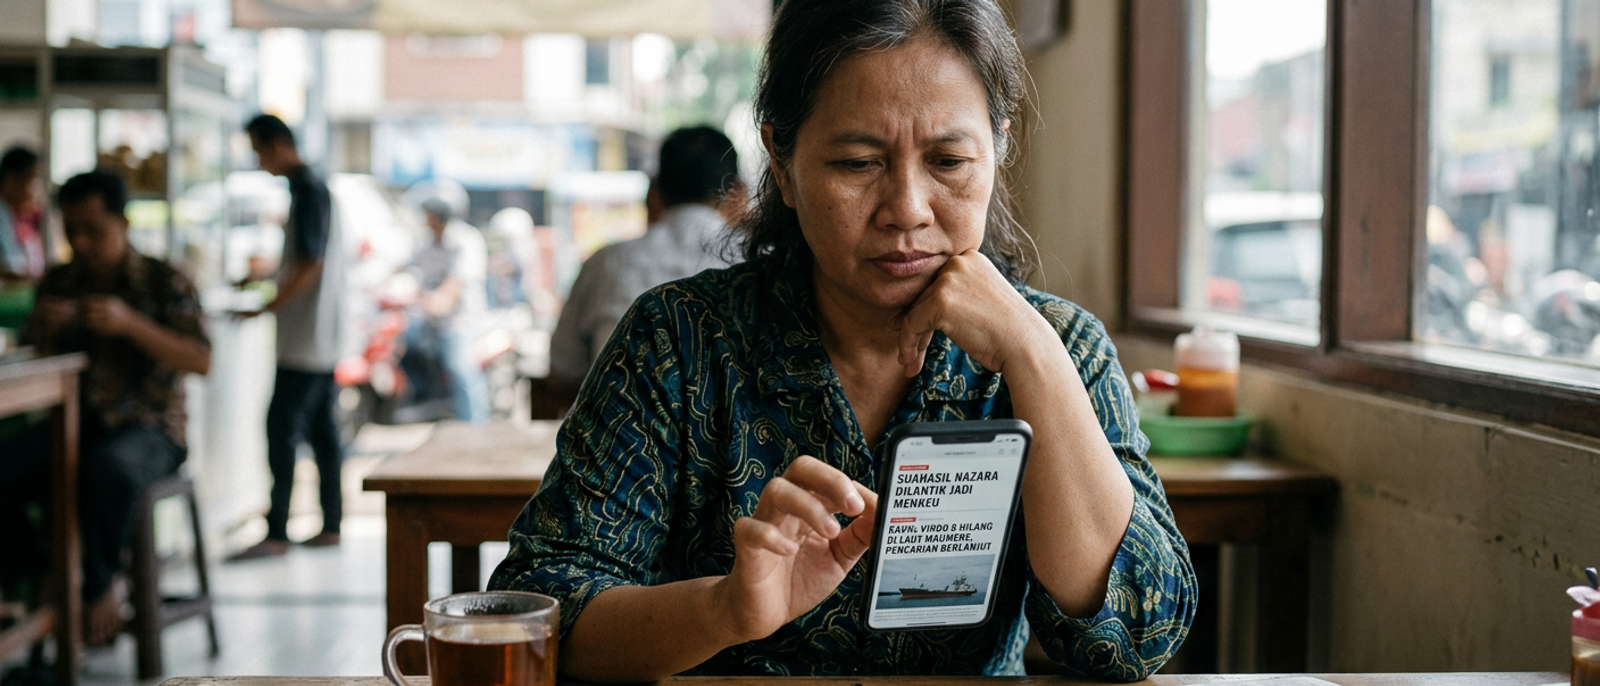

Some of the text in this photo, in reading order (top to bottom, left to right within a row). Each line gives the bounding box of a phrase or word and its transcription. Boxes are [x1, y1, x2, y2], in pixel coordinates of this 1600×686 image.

[897, 471, 998, 484] SUAHASIL NAZARA
[895, 484, 973, 496] DILANTIK JADI
[893, 498, 940, 508] MENKEU
[959, 522, 993, 531] HILANG
[899, 535, 923, 544] LAUT
[925, 533, 973, 543] MAUMERE,
[885, 542, 992, 555] PENCARIAN BERLANJUT
